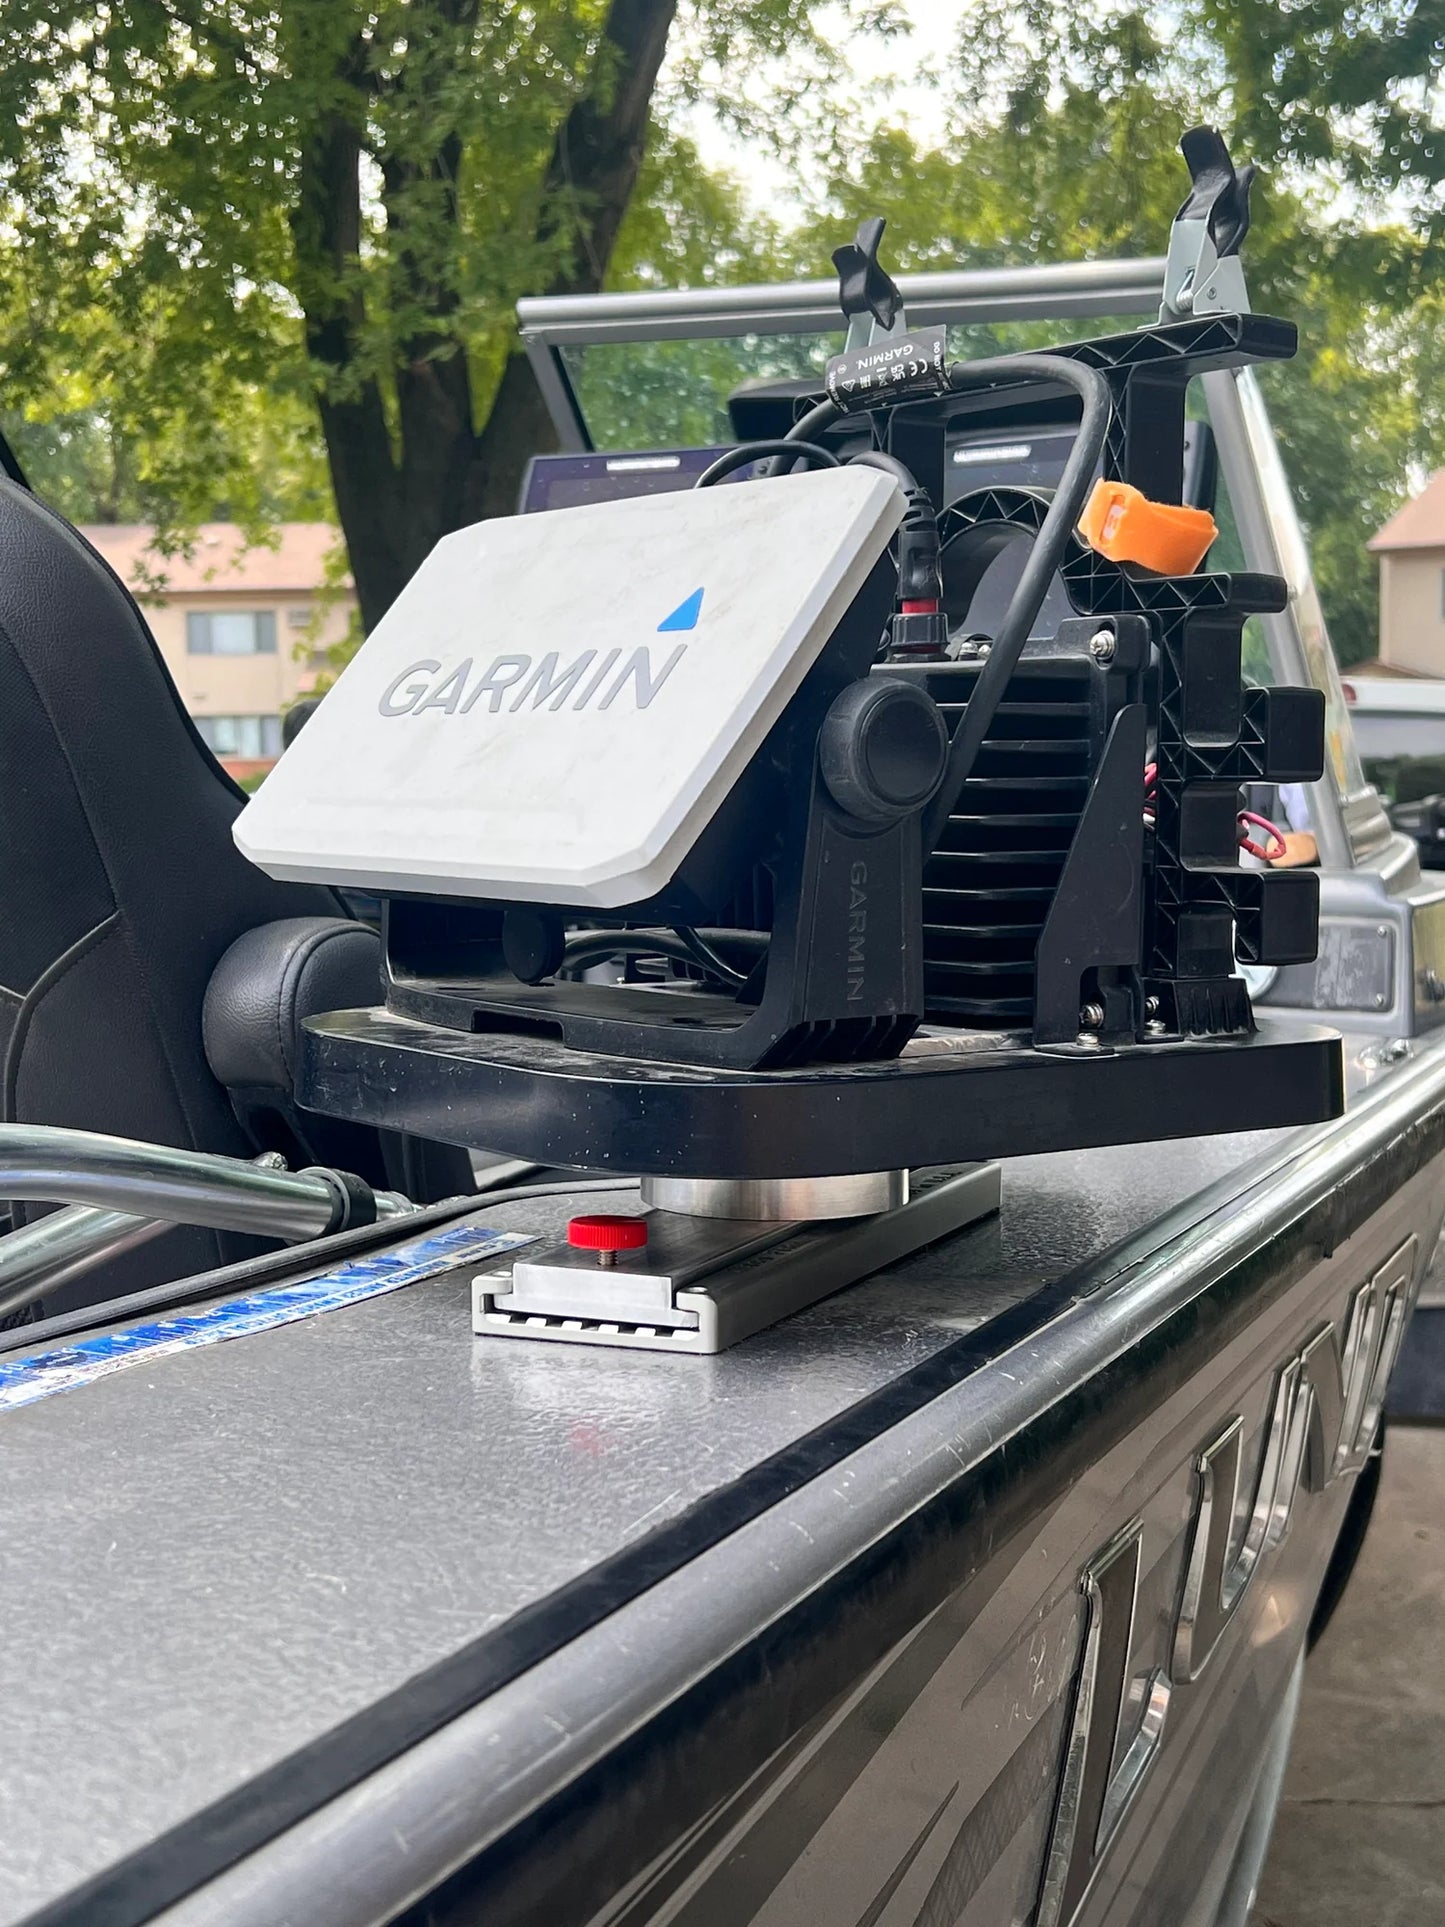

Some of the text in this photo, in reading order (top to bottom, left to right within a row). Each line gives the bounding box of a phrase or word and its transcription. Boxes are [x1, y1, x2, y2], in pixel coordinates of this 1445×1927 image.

[857, 344, 914, 371] GARMIN
[378, 643, 688, 717] GARMIN
[846, 860, 868, 1001] GARMIN
